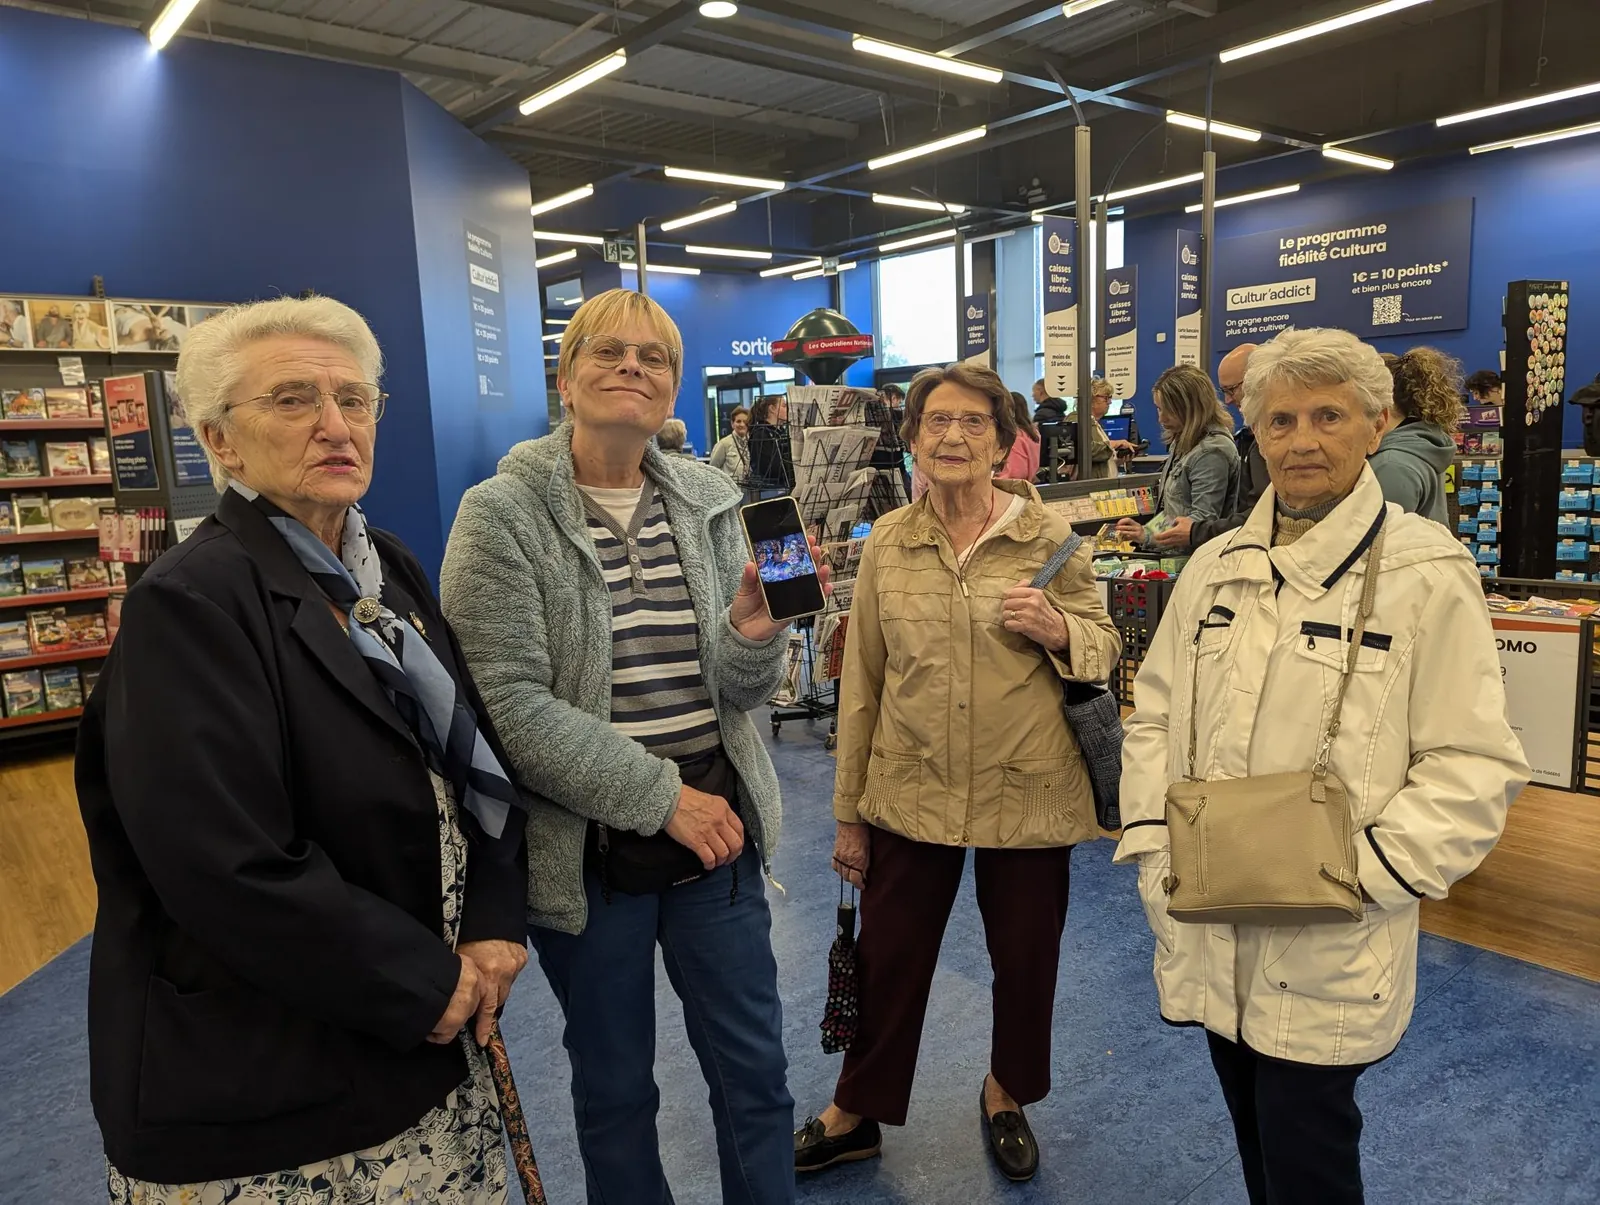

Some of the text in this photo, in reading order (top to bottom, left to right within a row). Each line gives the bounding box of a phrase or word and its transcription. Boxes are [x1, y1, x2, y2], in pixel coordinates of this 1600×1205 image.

[1279, 223, 1387, 251] Le programme
[1279, 241, 1387, 268] fidélité Cultura
[1048, 263, 1072, 274] caisses
[1051, 274, 1069, 284] libre-
[1181, 272, 1198, 282] caisses
[1352, 271, 1368, 284] 1€
[1370, 272, 1379, 280] =
[1381, 267, 1396, 280] 10
[1048, 284, 1072, 294] service
[1351, 278, 1432, 295] et bien plus encore
[1180, 292, 1198, 300] service
[1230, 284, 1311, 305] Cultur'addict
[1108, 300, 1131, 309] caisses
[1111, 309, 1129, 317] libre-
[1108, 316, 1131, 324] service
[1225, 313, 1290, 327] On gagne encore
[1225, 326, 1242, 337] plus
[1242, 325, 1248, 334] à
[1258, 323, 1287, 333] cultiver
[820, 340, 853, 349] Quotidiens
